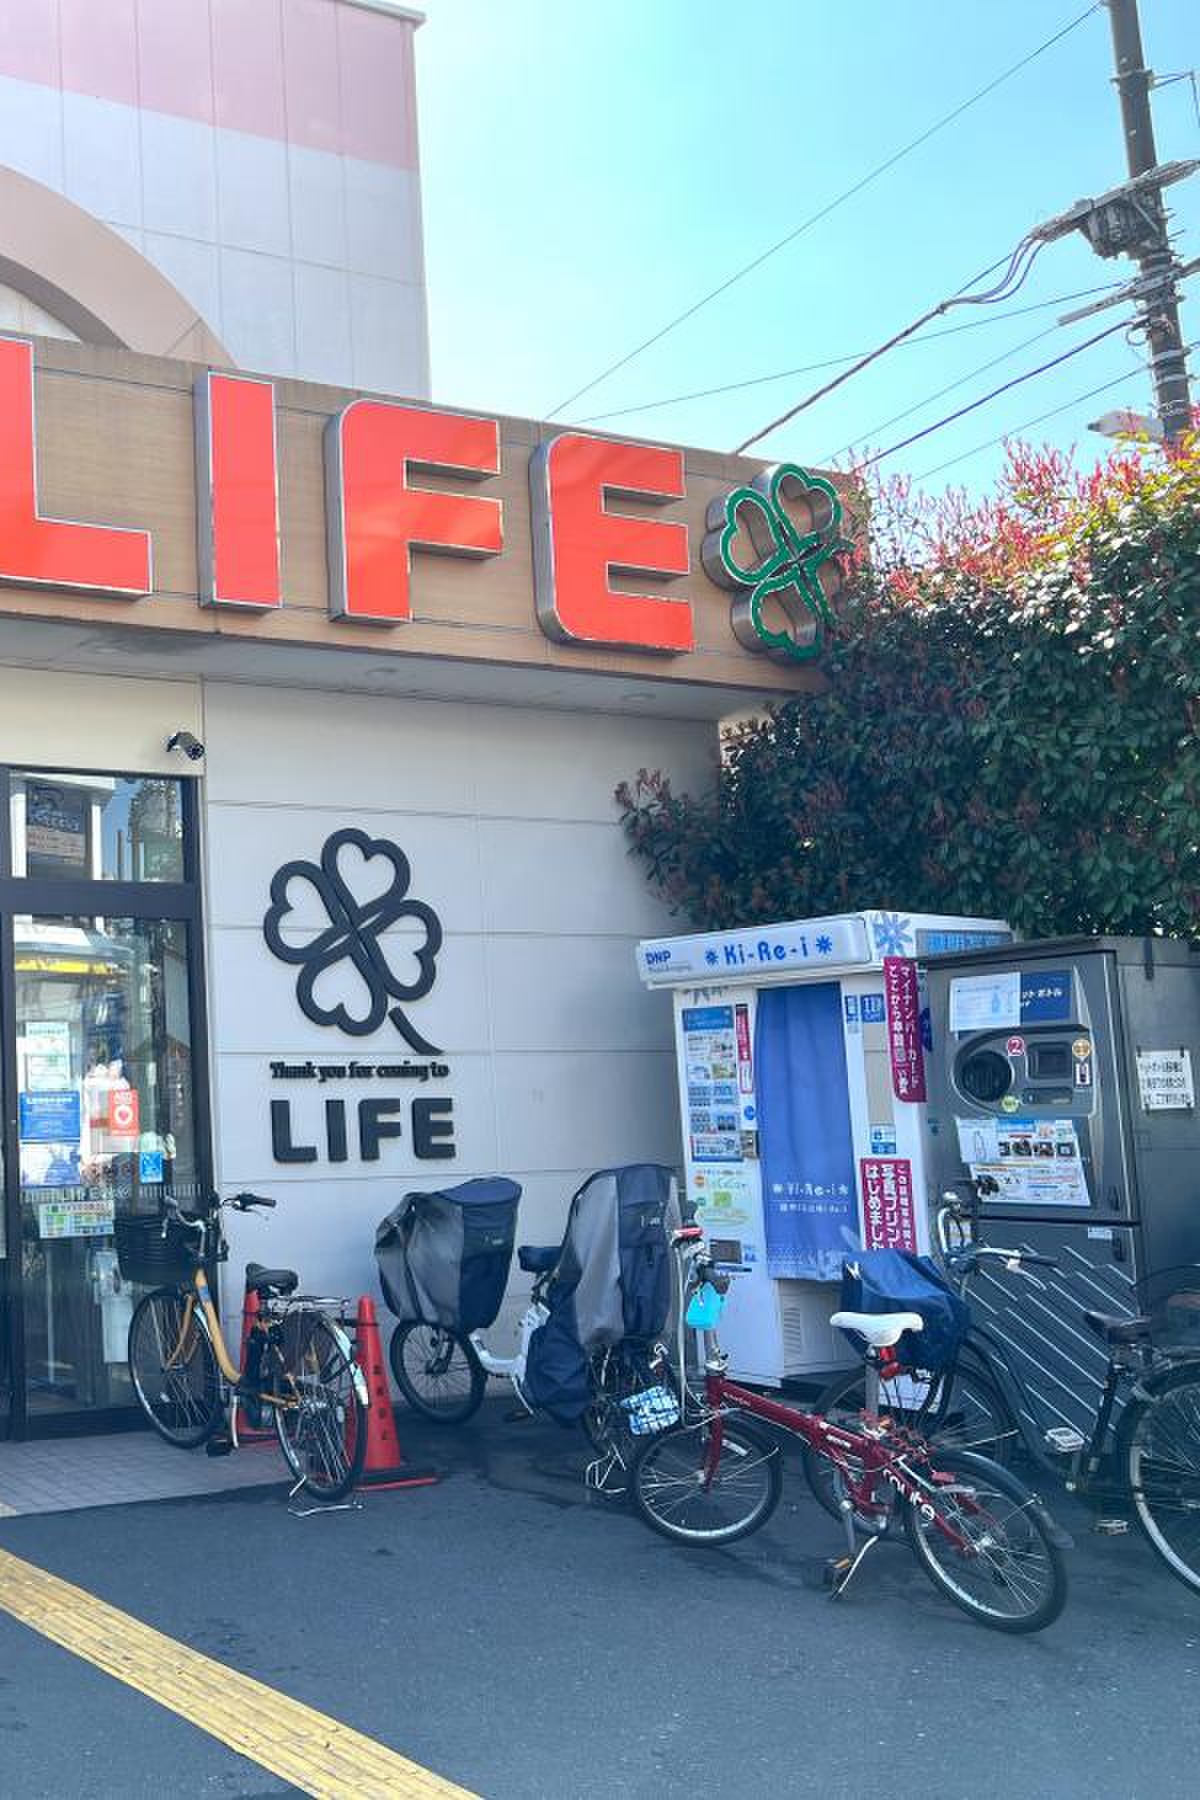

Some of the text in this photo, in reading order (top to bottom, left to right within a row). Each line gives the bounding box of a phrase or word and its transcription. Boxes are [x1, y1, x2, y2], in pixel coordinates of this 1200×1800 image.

[646, 950, 671, 965] DNP
[1011, 1039, 1021, 1053] 2
[270, 1061, 449, 1083] Thank you for coming to
[270, 1098, 456, 1163] LIFE
